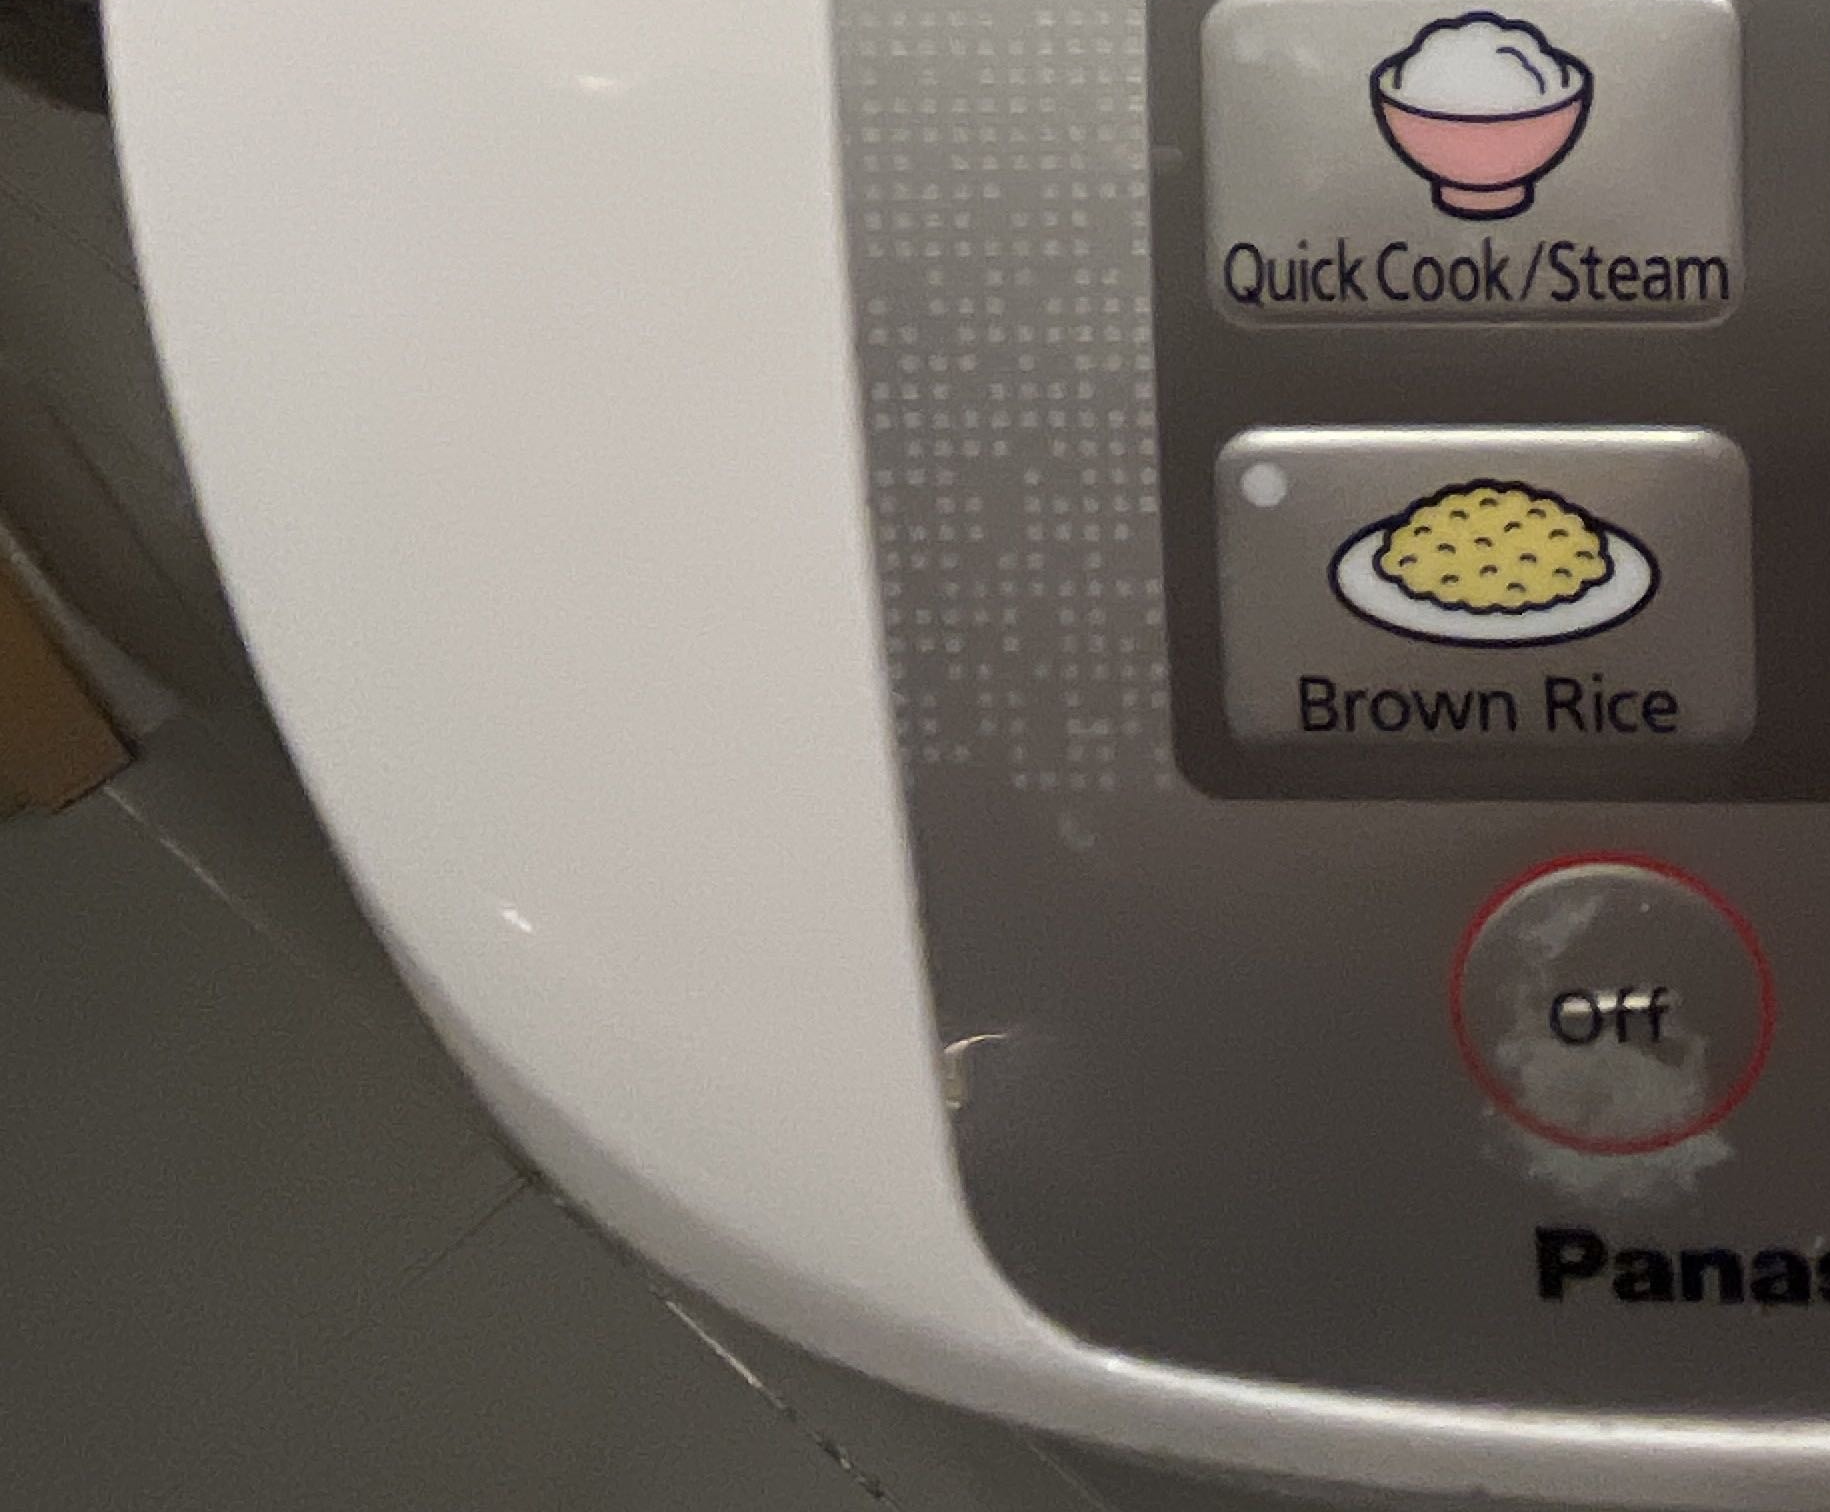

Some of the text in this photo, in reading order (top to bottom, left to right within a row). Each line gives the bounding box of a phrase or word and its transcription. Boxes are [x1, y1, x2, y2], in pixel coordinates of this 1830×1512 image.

[1223, 236, 1730, 308] Quick Cook/Steam
[1299, 673, 1680, 733] Brown Rice
[1549, 985, 1670, 1045] Off
